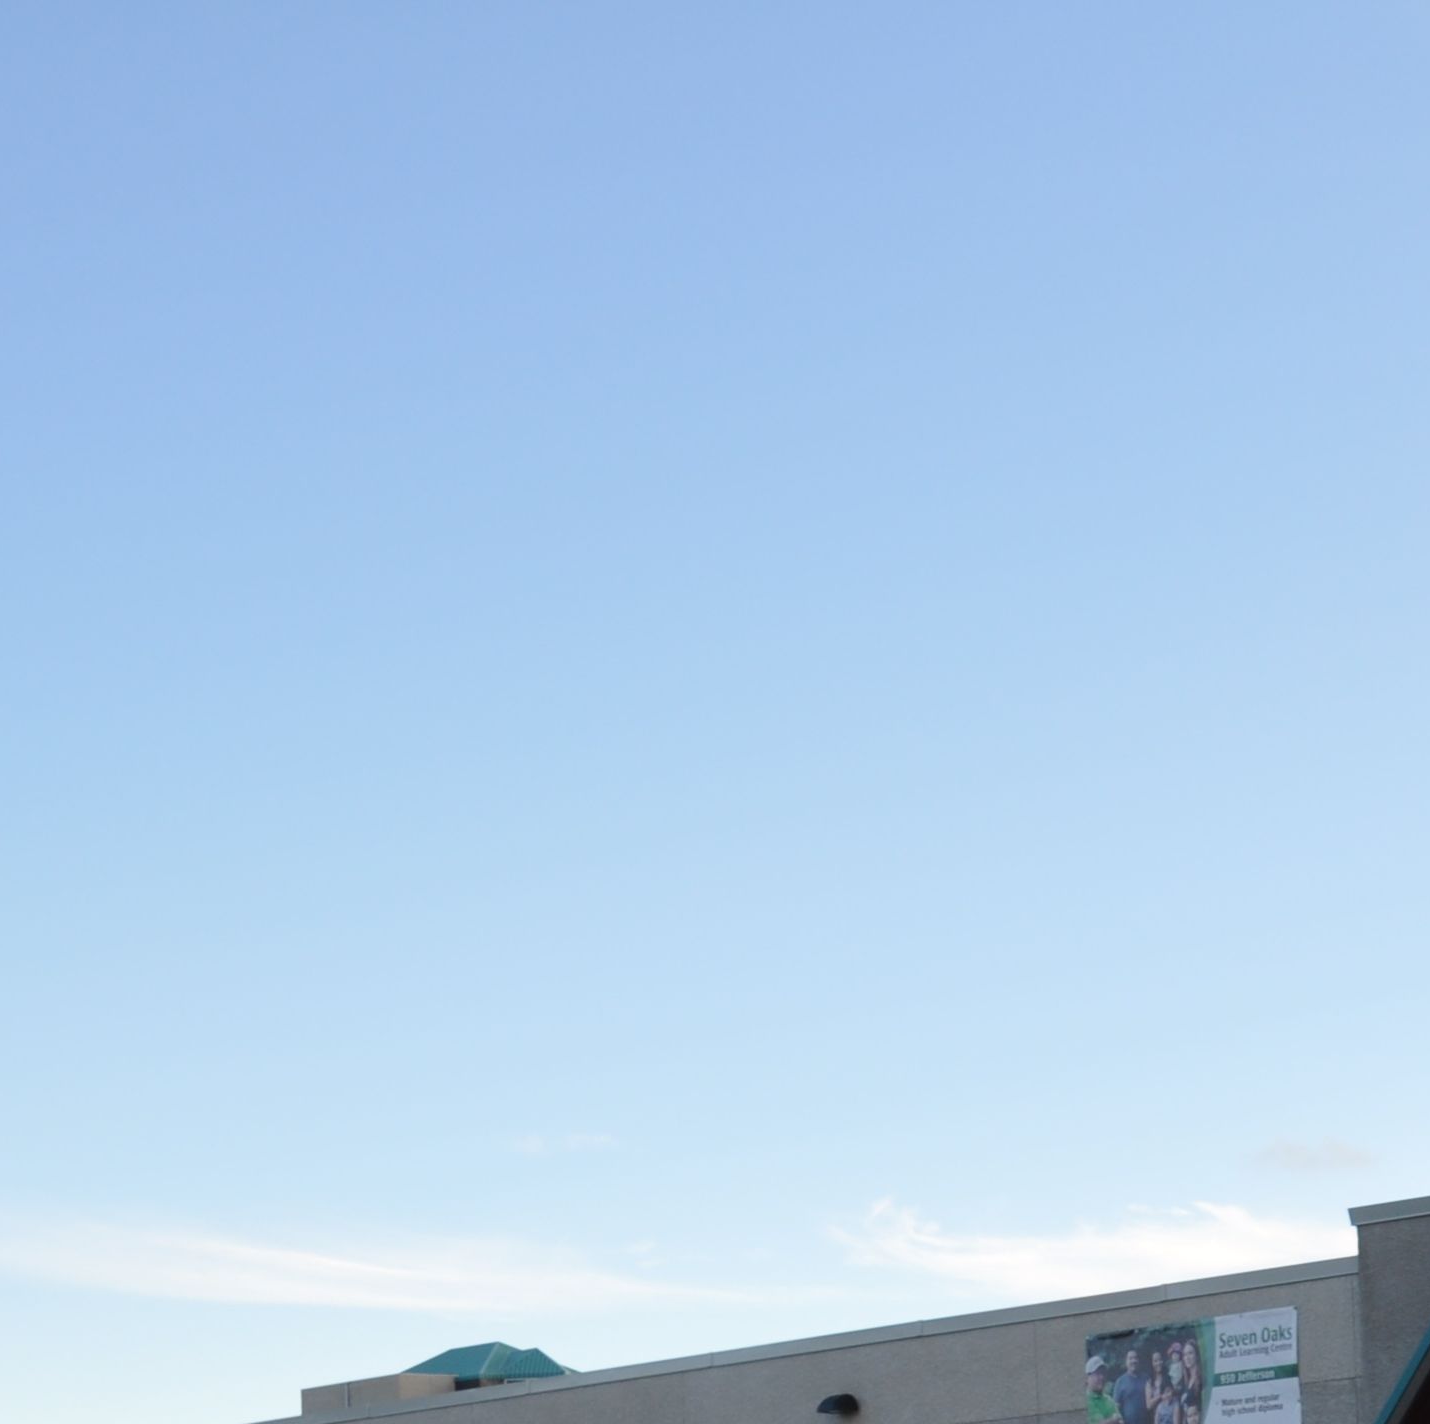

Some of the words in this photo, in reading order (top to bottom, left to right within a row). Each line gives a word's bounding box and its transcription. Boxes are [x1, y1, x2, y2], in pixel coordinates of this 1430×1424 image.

[1219, 1332, 1258, 1350] Seven
[1261, 1325, 1293, 1344] Oaks
[1219, 1349, 1238, 1359] Adult
[1239, 1346, 1269, 1357] Learning
[1238, 1369, 1275, 1382] Jefferson
